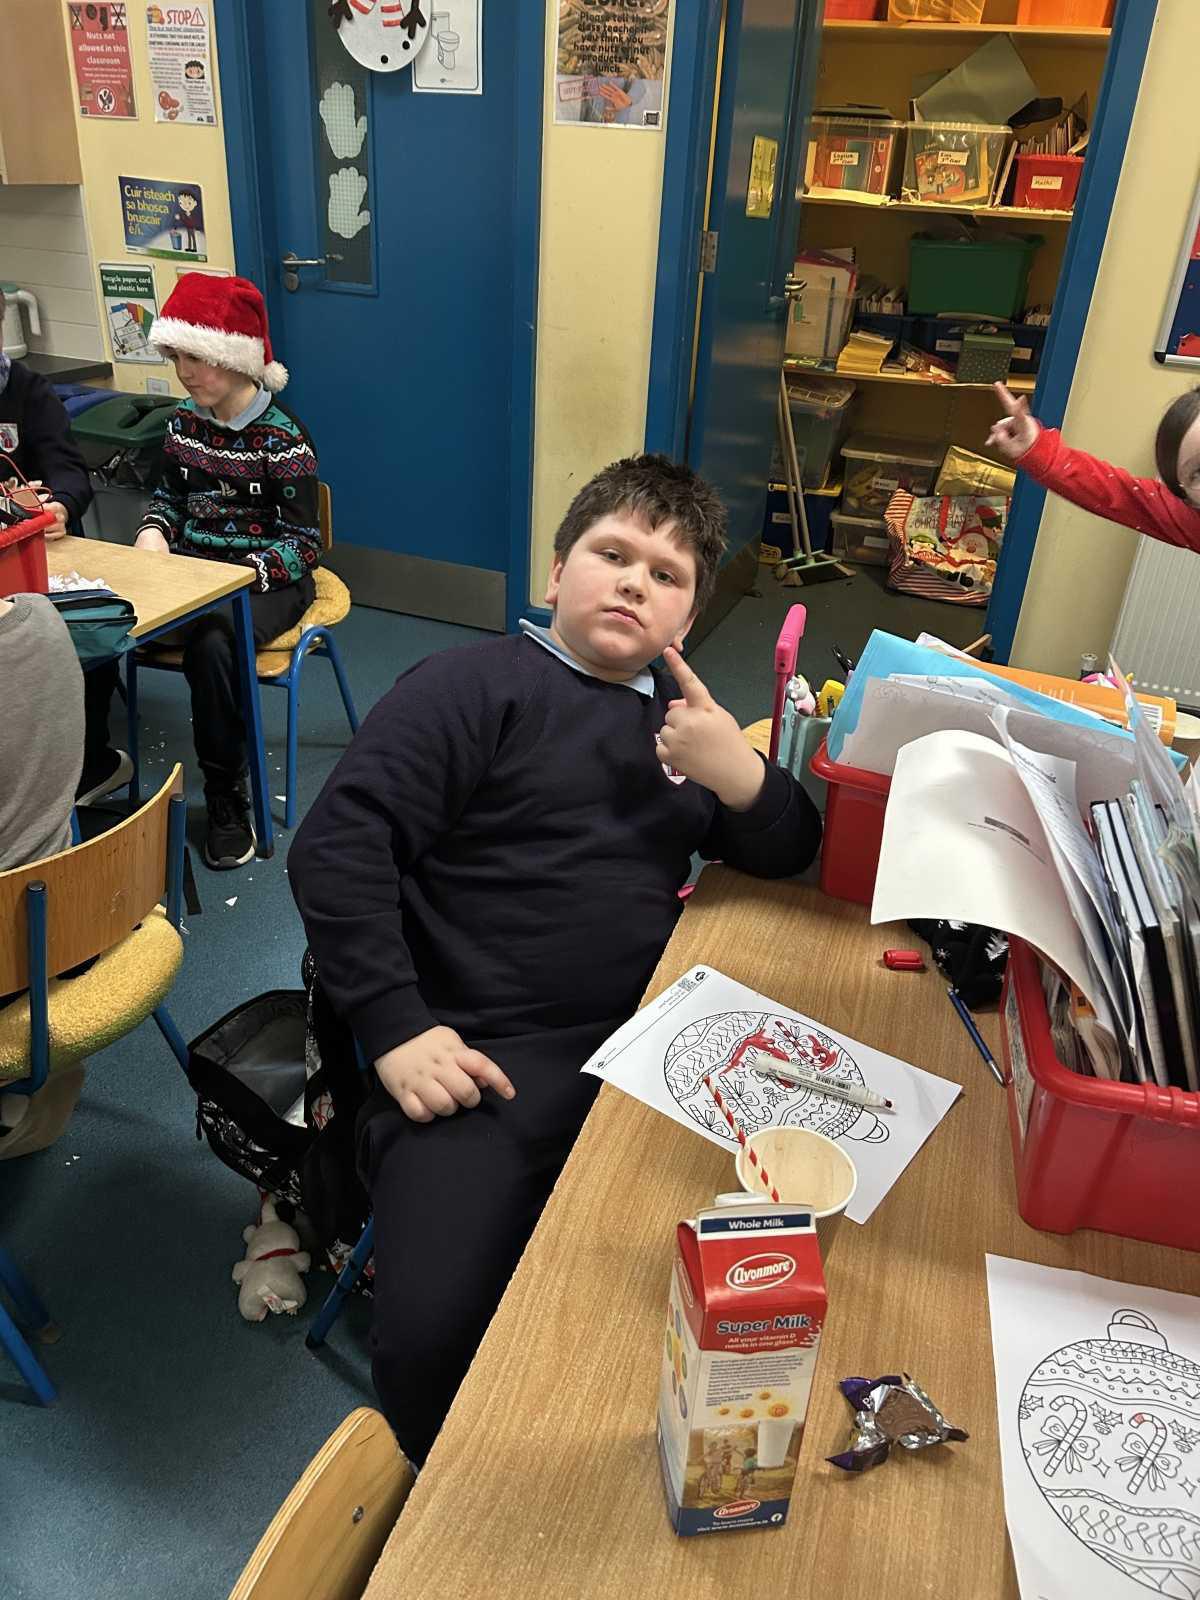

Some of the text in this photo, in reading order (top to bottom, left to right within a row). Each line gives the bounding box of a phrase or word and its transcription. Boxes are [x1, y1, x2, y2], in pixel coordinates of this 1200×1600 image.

[167, 9, 192, 25] STOP
[86, 31, 115, 40] Nuts not
[581, 31, 643, 45] you think you
[78, 44, 127, 53] allowed in this
[574, 40, 596, 52] have
[86, 55, 121, 65] classroom
[582, 53, 622, 64] products
[124, 184, 176, 203] Cuir isteach
[127, 199, 169, 214] sa bhosca
[127, 210, 161, 225] bruscair
[103, 274, 121, 284] Recycle
[139, 276, 151, 284] card
[107, 283, 118, 291] and
[728, 1217, 785, 1230] Whole Milk
[716, 1313, 812, 1336] Super Milk
[740, 1336, 758, 1344] your
[759, 1333, 789, 1342] vitamin
[724, 1342, 749, 1350] needs
